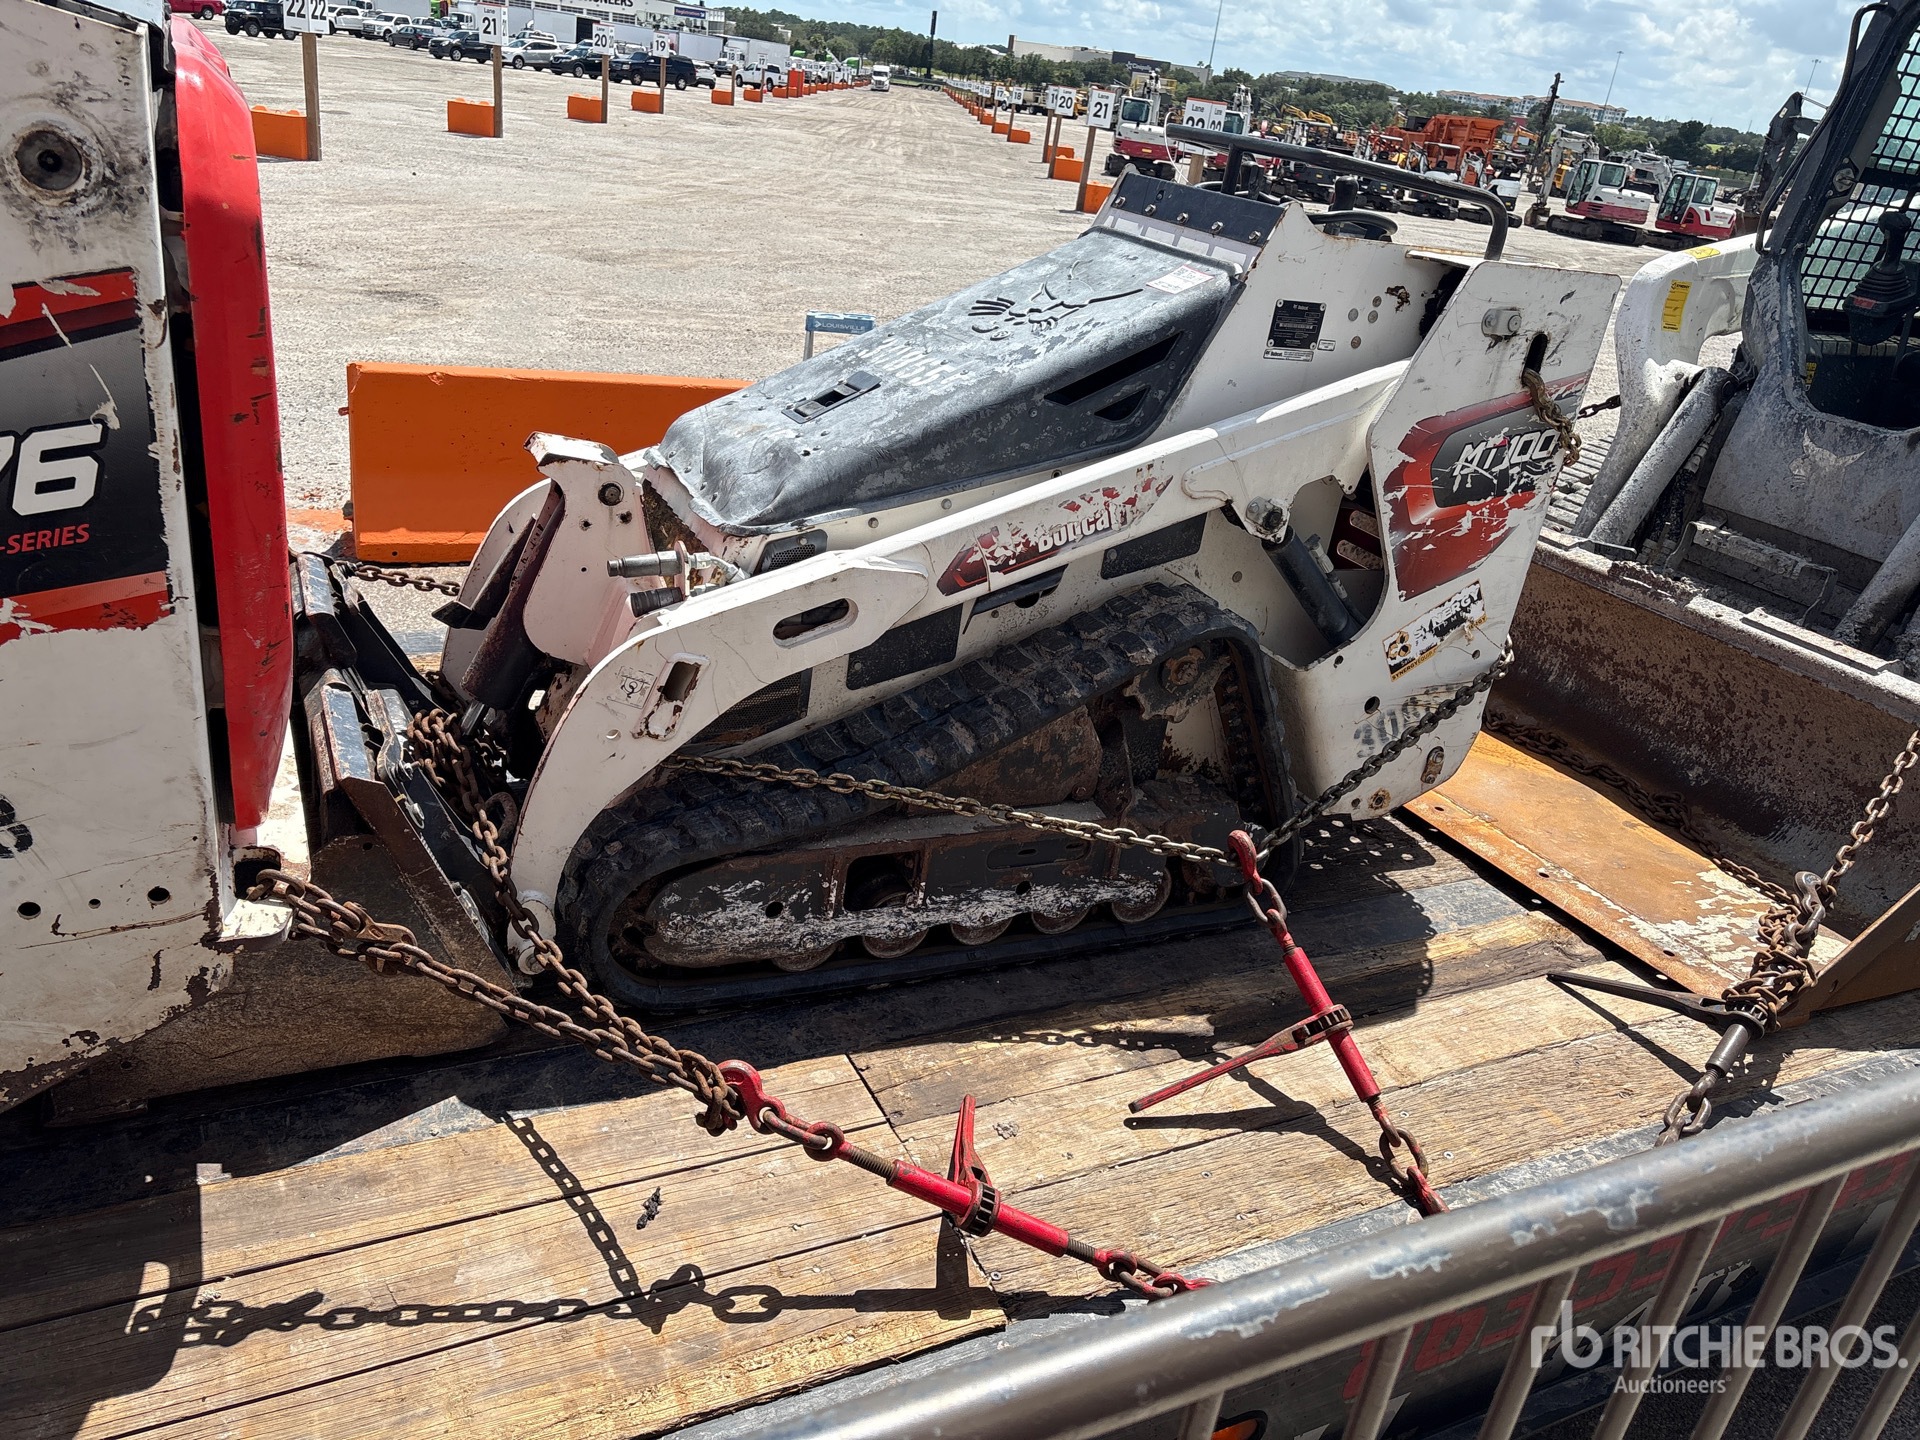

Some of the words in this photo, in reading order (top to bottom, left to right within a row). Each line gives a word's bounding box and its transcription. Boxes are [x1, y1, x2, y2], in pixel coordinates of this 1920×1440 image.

[482, 16, 497, 36] 21
[594, 33, 608, 48] 20
[656, 40, 666, 52] 19
[1014, 91, 1022, 100] 18
[1051, 93, 1058, 104] 1
[1058, 95, 1073, 109] 20
[1092, 101, 1109, 119] 21
[1191, 104, 1205, 113] Lane
[822, 322, 866, 332] LOUISVILLE
[0, 423, 103, 516] 6
